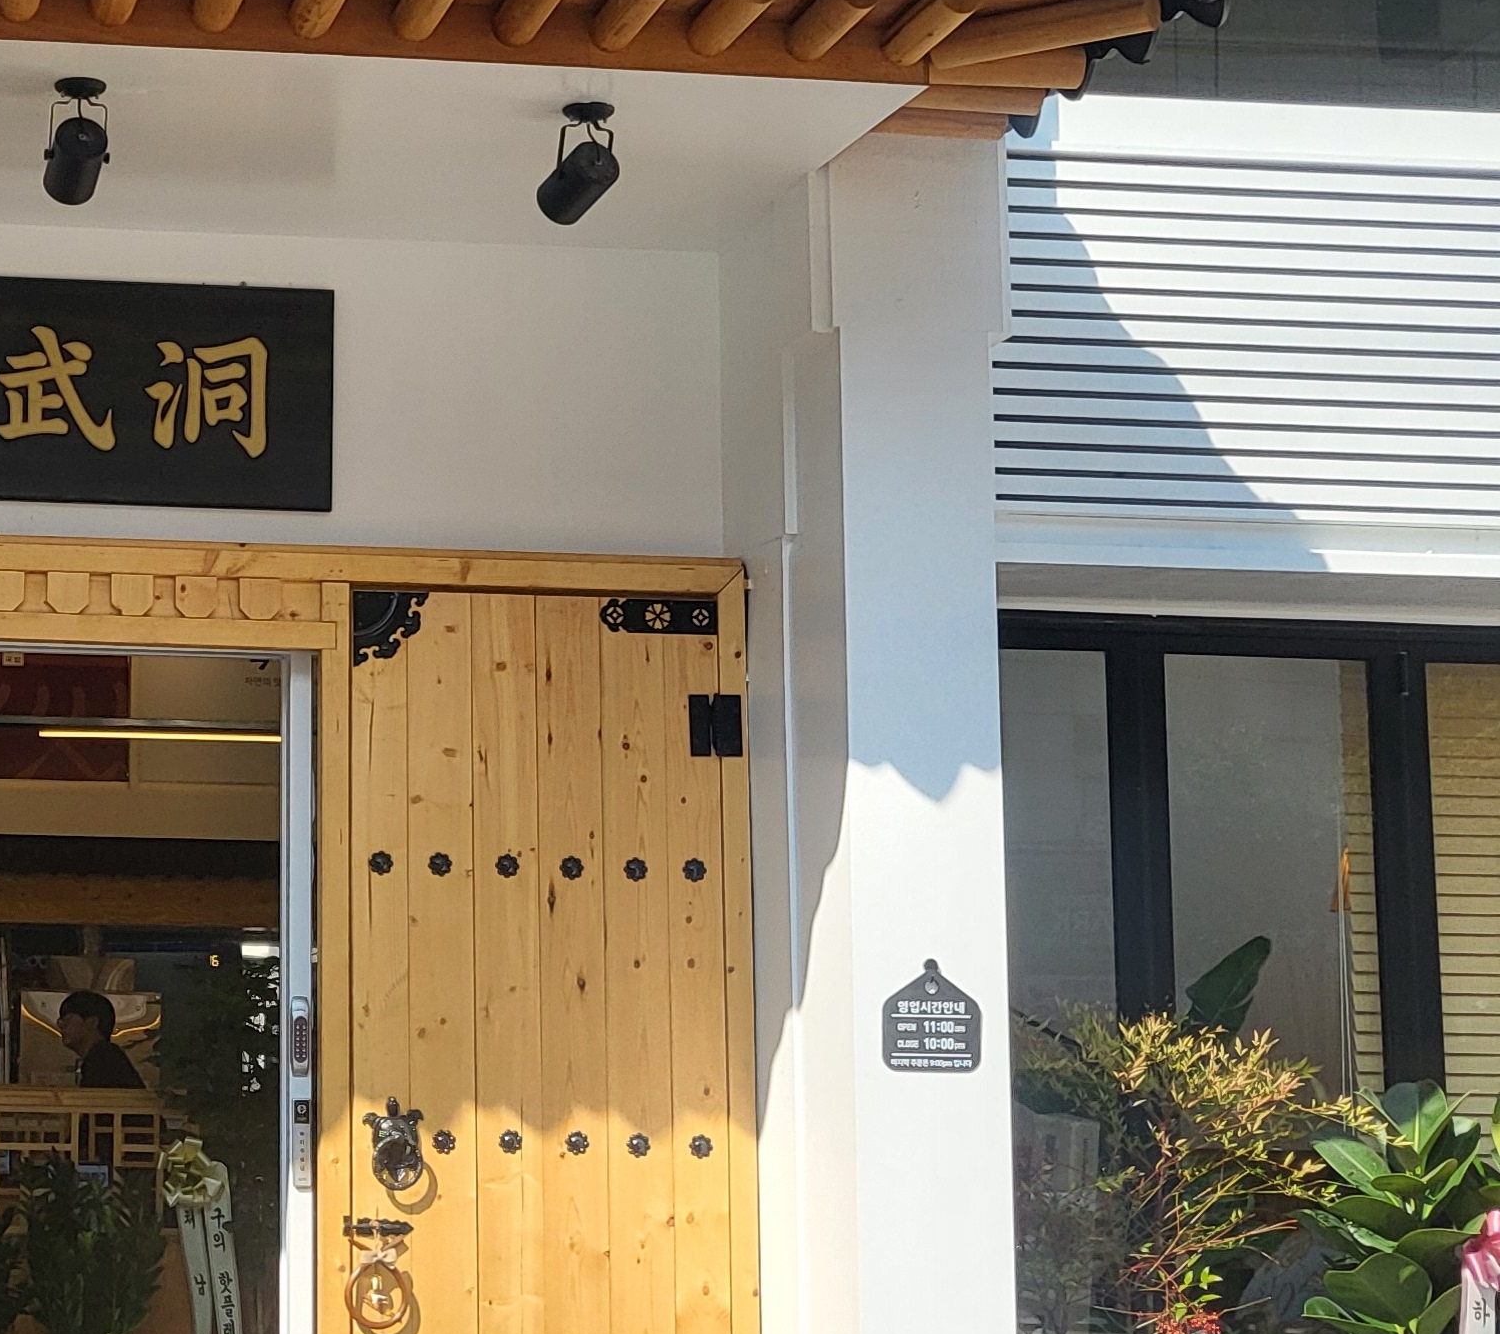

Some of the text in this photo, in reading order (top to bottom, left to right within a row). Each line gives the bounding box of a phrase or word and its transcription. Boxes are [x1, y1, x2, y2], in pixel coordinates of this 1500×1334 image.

[897, 1000, 966, 1014] 영업시간안내
[897, 1022, 917, 1032] OPEN
[897, 1039, 920, 1049] CLOSE
